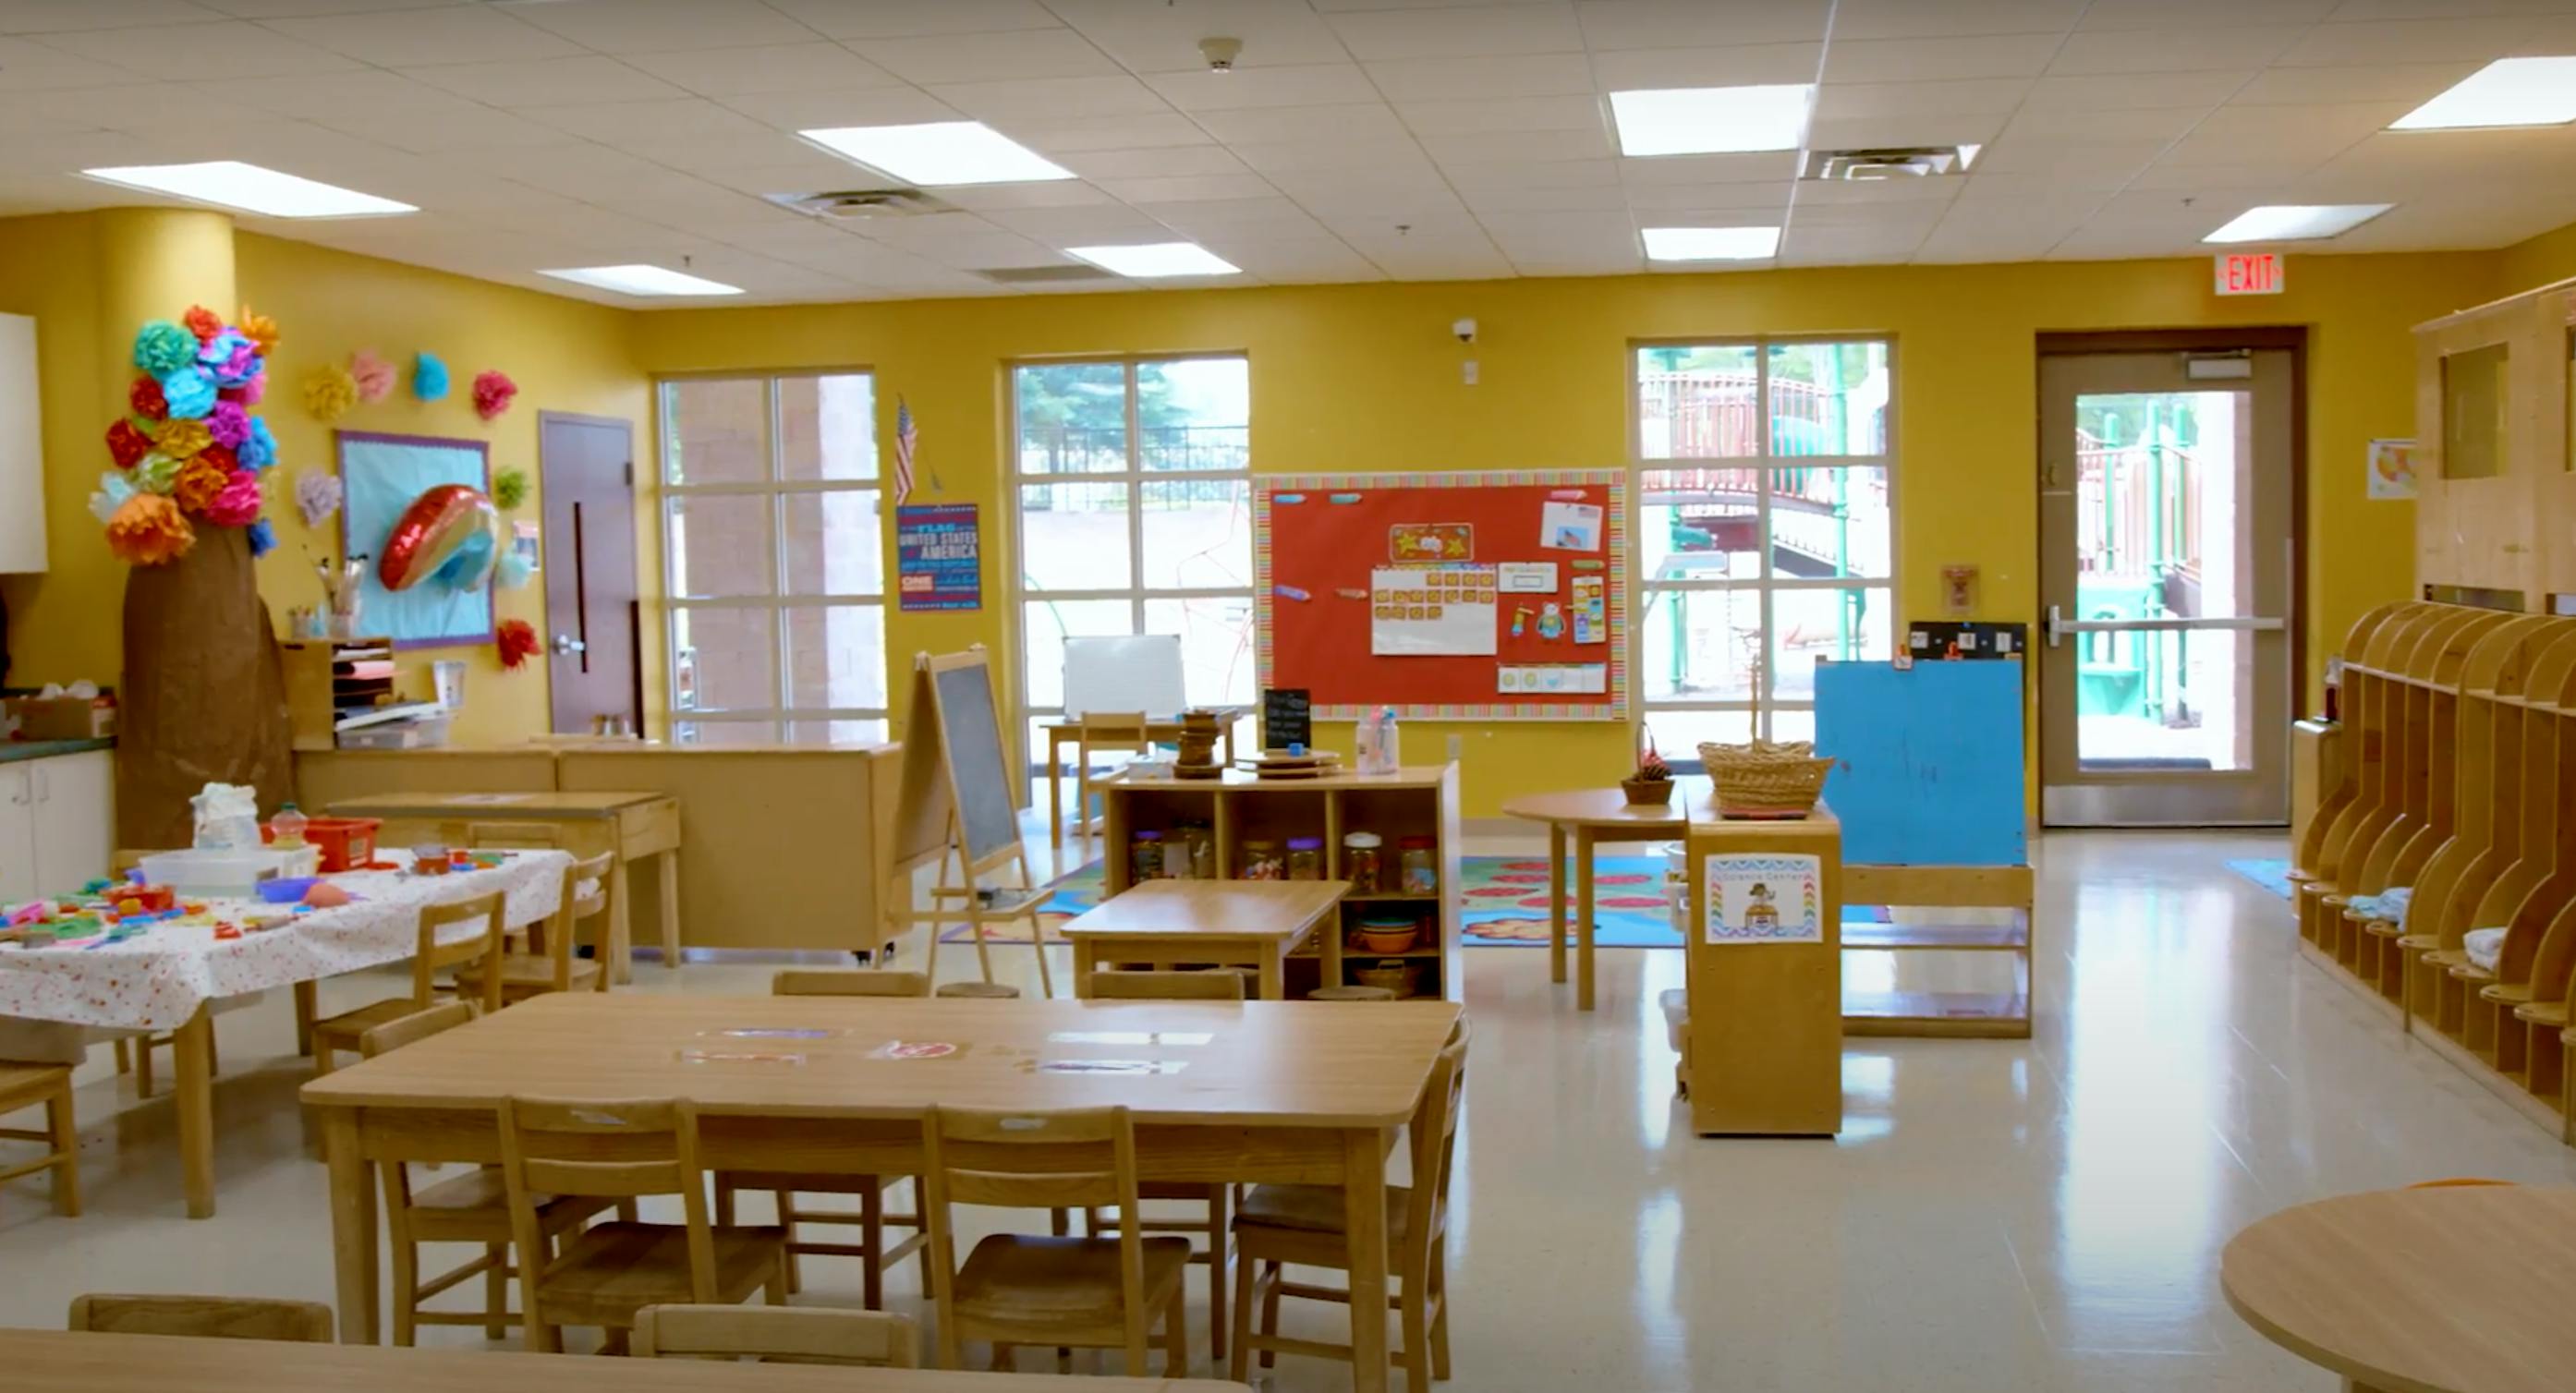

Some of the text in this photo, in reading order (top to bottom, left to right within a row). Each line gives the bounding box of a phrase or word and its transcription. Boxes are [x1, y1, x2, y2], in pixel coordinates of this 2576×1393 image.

[2228, 254, 2273, 291] EXIT
[917, 524, 955, 533] FLAG
[899, 531, 978, 547] UNITED STATES
[920, 545, 978, 560] AMERICA
